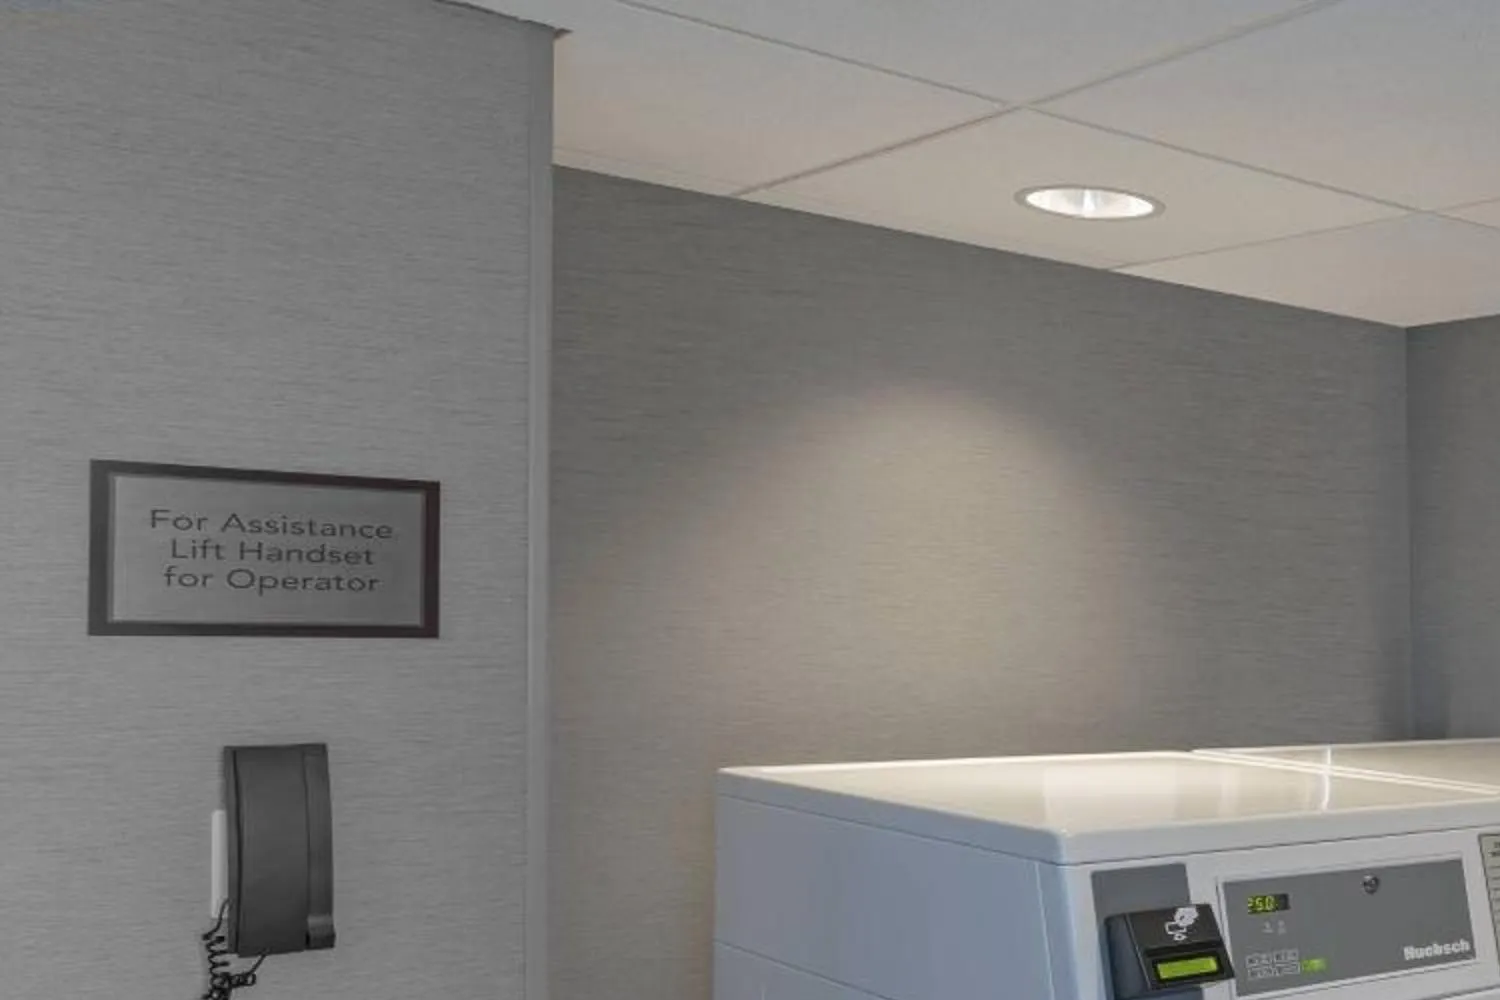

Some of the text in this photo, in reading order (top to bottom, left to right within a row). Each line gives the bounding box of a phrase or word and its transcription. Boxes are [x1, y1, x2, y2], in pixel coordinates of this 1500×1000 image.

[150, 509, 393, 539] For Assistance
[171, 539, 375, 565] Lift Handset
[164, 566, 379, 596] for Operator
